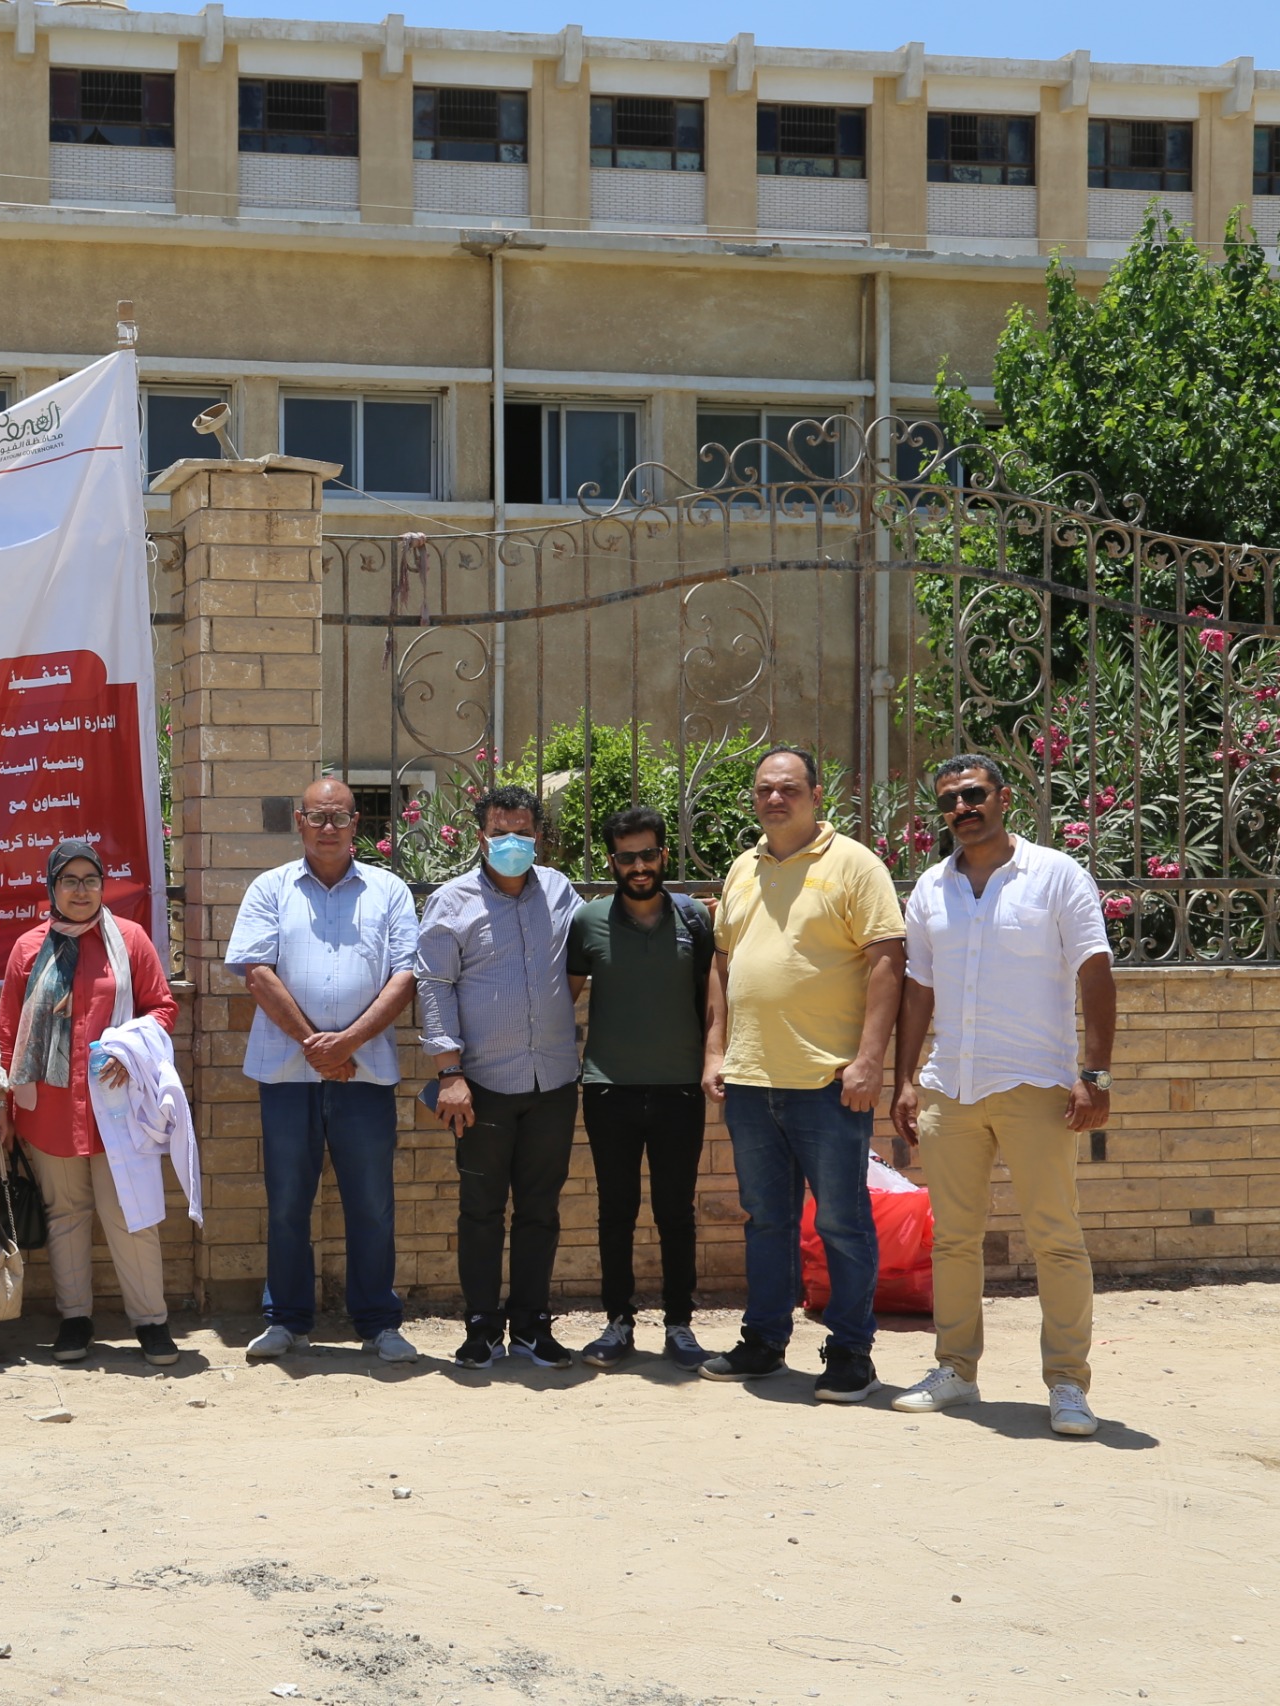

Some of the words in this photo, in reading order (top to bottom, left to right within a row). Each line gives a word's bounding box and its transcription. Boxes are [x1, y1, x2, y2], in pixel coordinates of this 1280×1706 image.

[25, 432, 64, 446] محافظة
[0, 452, 22, 462] FAYOUM
[22, 441, 65, 456] GOVERNORATE
[8, 665, 72, 694] تنفيذ
[0, 720, 40, 738] لخدمة
[43, 716, 80, 732] العامة
[84, 714, 116, 734] الإدارة
[42, 755, 84, 774] وتنمية
[9, 800, 27, 814] مع
[32, 792, 80, 813] بالتعاون
[27, 833, 54, 849] حياة
[59, 829, 101, 846] مؤسسة
[8, 871, 32, 889] طب
[107, 862, 132, 880] كلية
